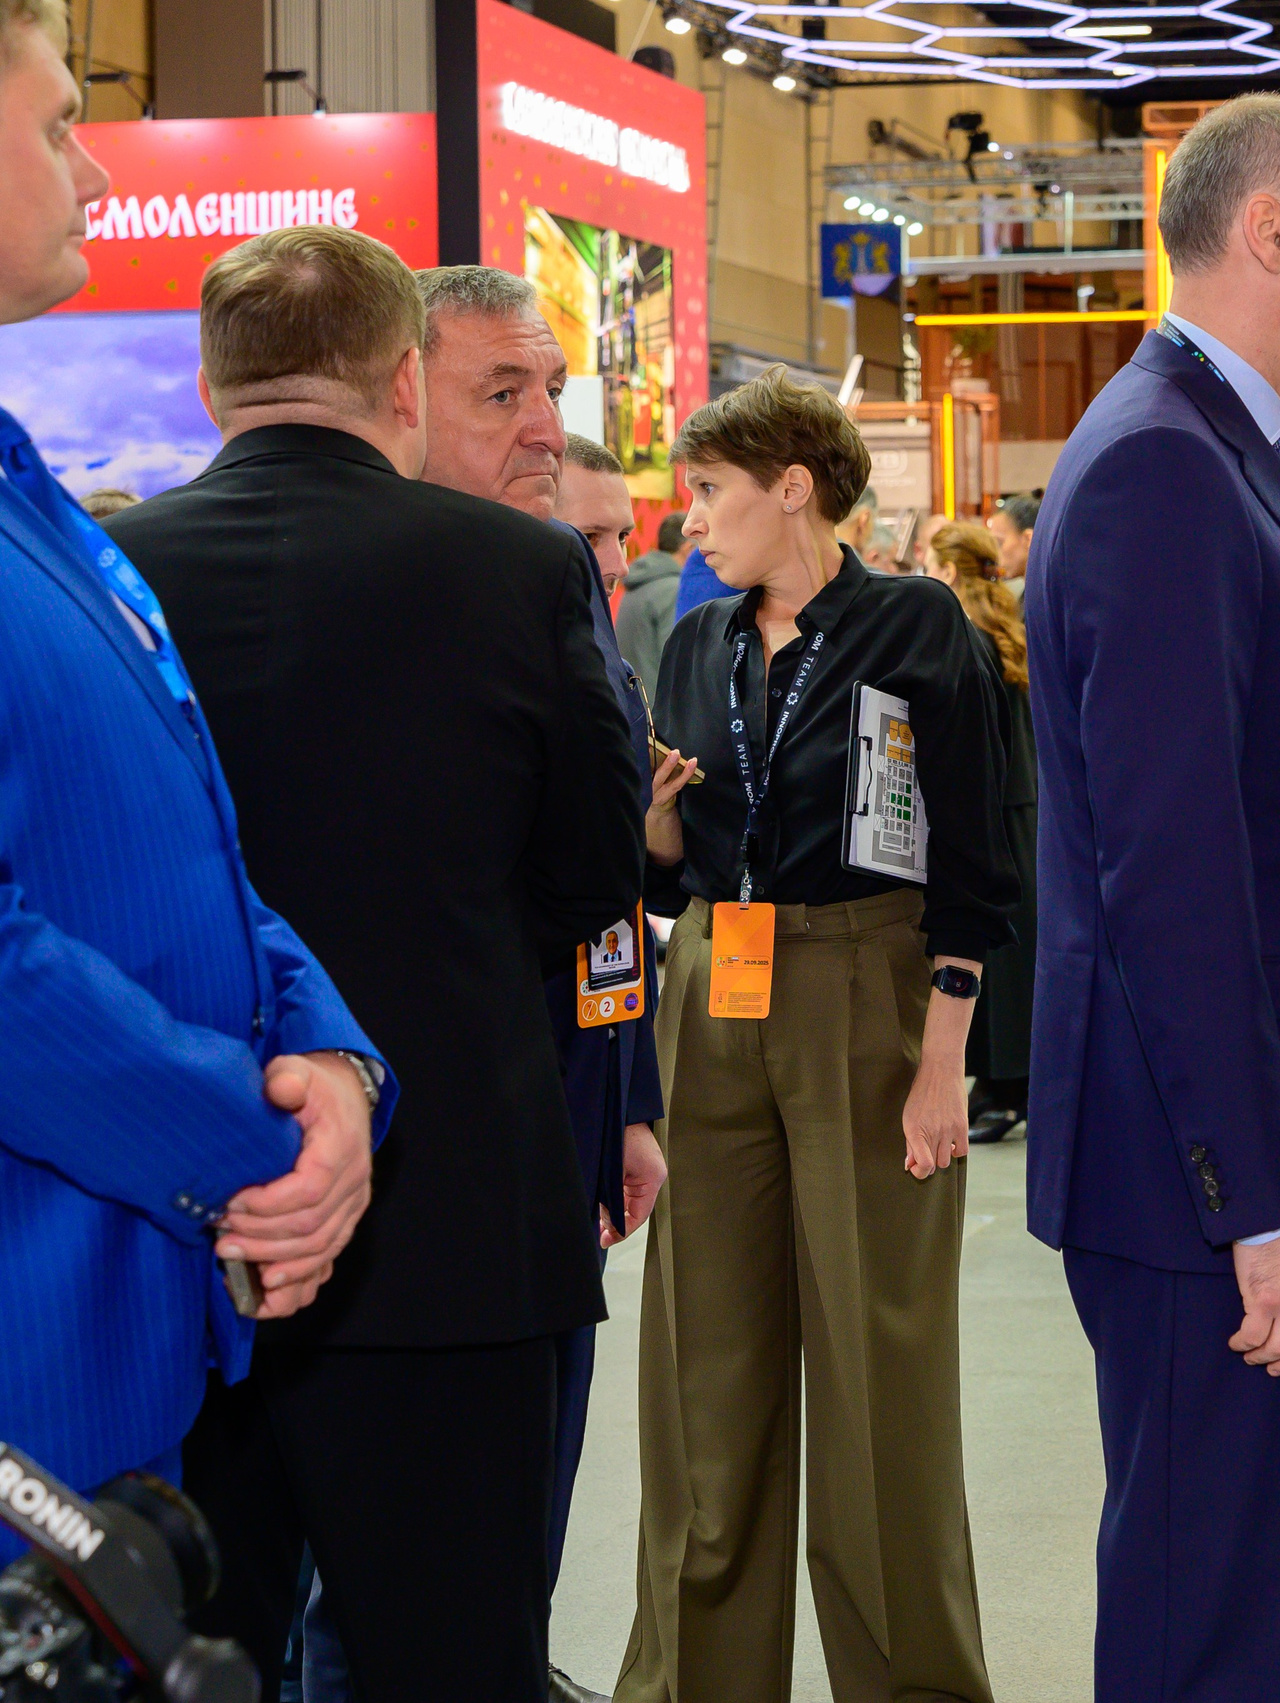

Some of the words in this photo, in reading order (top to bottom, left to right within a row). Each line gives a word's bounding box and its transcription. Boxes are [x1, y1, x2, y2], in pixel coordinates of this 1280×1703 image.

[737, 743, 750, 776] TEAM
[603, 1001, 611, 1013] 2
[0, 1458, 105, 1562] RONIN
